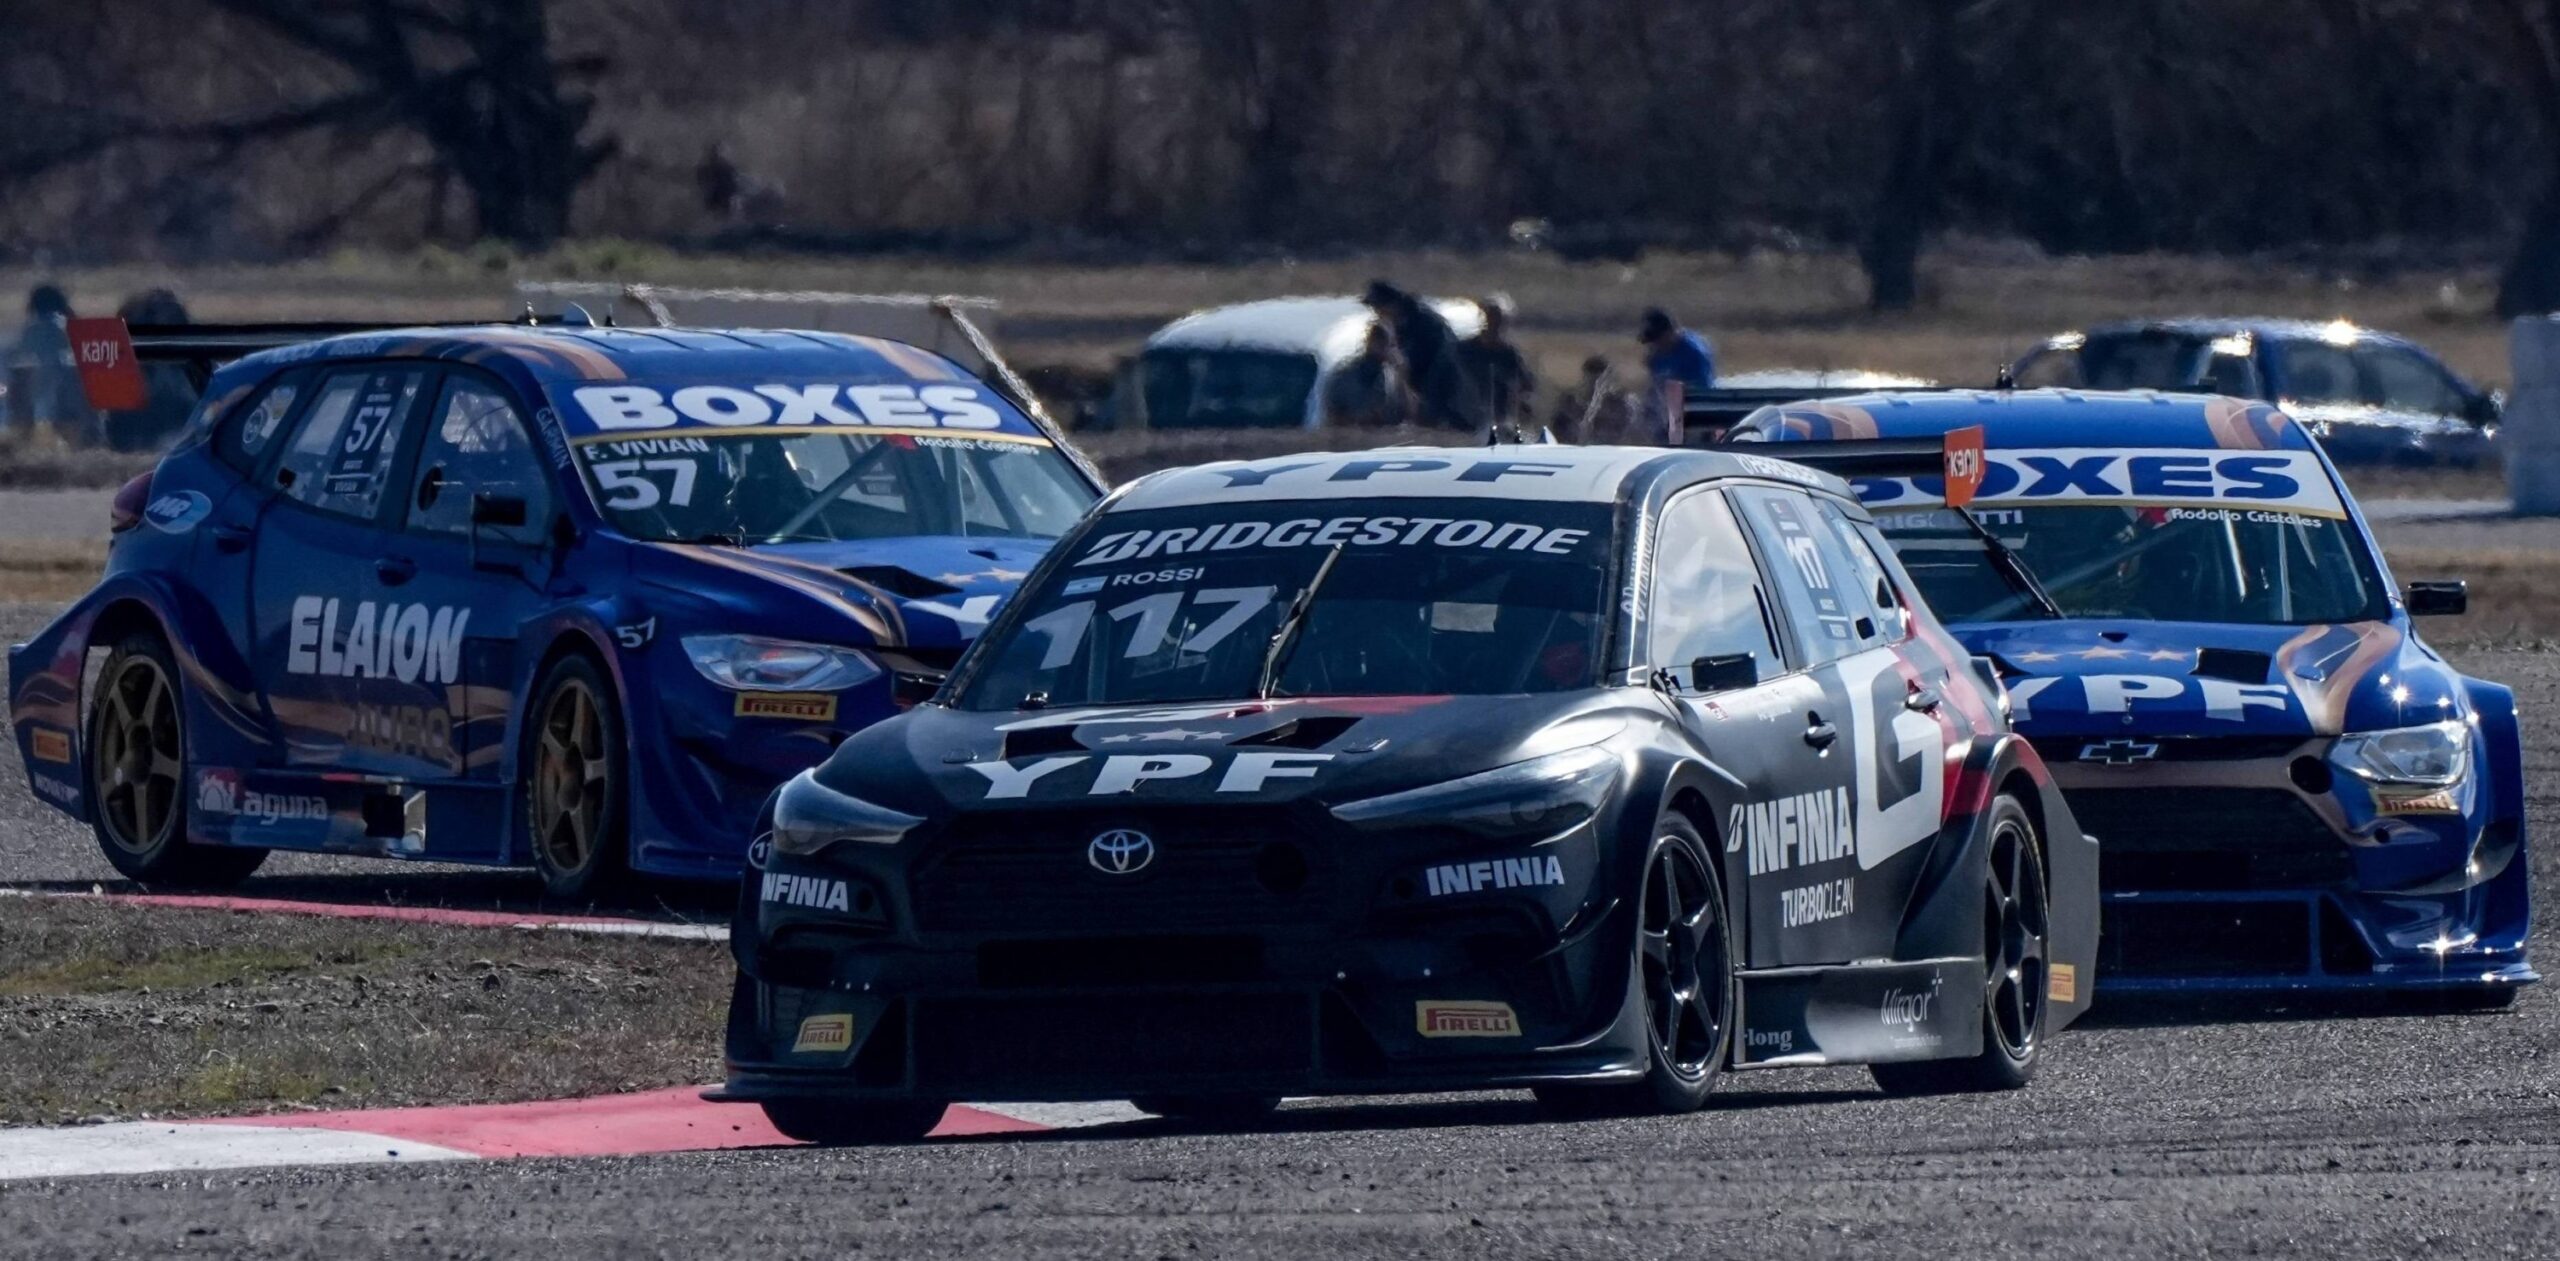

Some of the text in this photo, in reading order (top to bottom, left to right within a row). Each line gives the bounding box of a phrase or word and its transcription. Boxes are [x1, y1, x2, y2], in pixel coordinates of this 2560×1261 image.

[573, 385, 1001, 430] BOXES
[345, 406, 391, 453] 57
[583, 437, 710, 461] F. VIVIAN
[592, 459, 698, 511] 57
[1213, 460, 1574, 488] YPF
[1950, 447, 1979, 484] kanji
[2171, 508, 2323, 528] Rodolfo Cristales
[1073, 517, 1589, 567] BRIDGESTONE
[1112, 567, 1205, 586] ROSSI
[287, 596, 471, 684] ELAION
[616, 616, 656, 648] 57
[1024, 585, 1278, 670] 117
[742, 698, 829, 717] PIRELLI
[964, 753, 1336, 799] YPF
[228, 781, 328, 826] Laguna
[1746, 786, 1855, 877] INFINIA
[761, 872, 849, 913] NFINIA
[1426, 855, 1565, 897] INFINIA
[1781, 877, 1855, 929] TURBOCLEAN
[1426, 1007, 1513, 1032] PIRELLI
[1880, 988, 1933, 1033] Mirgor
[1744, 1029, 1793, 1051] long
